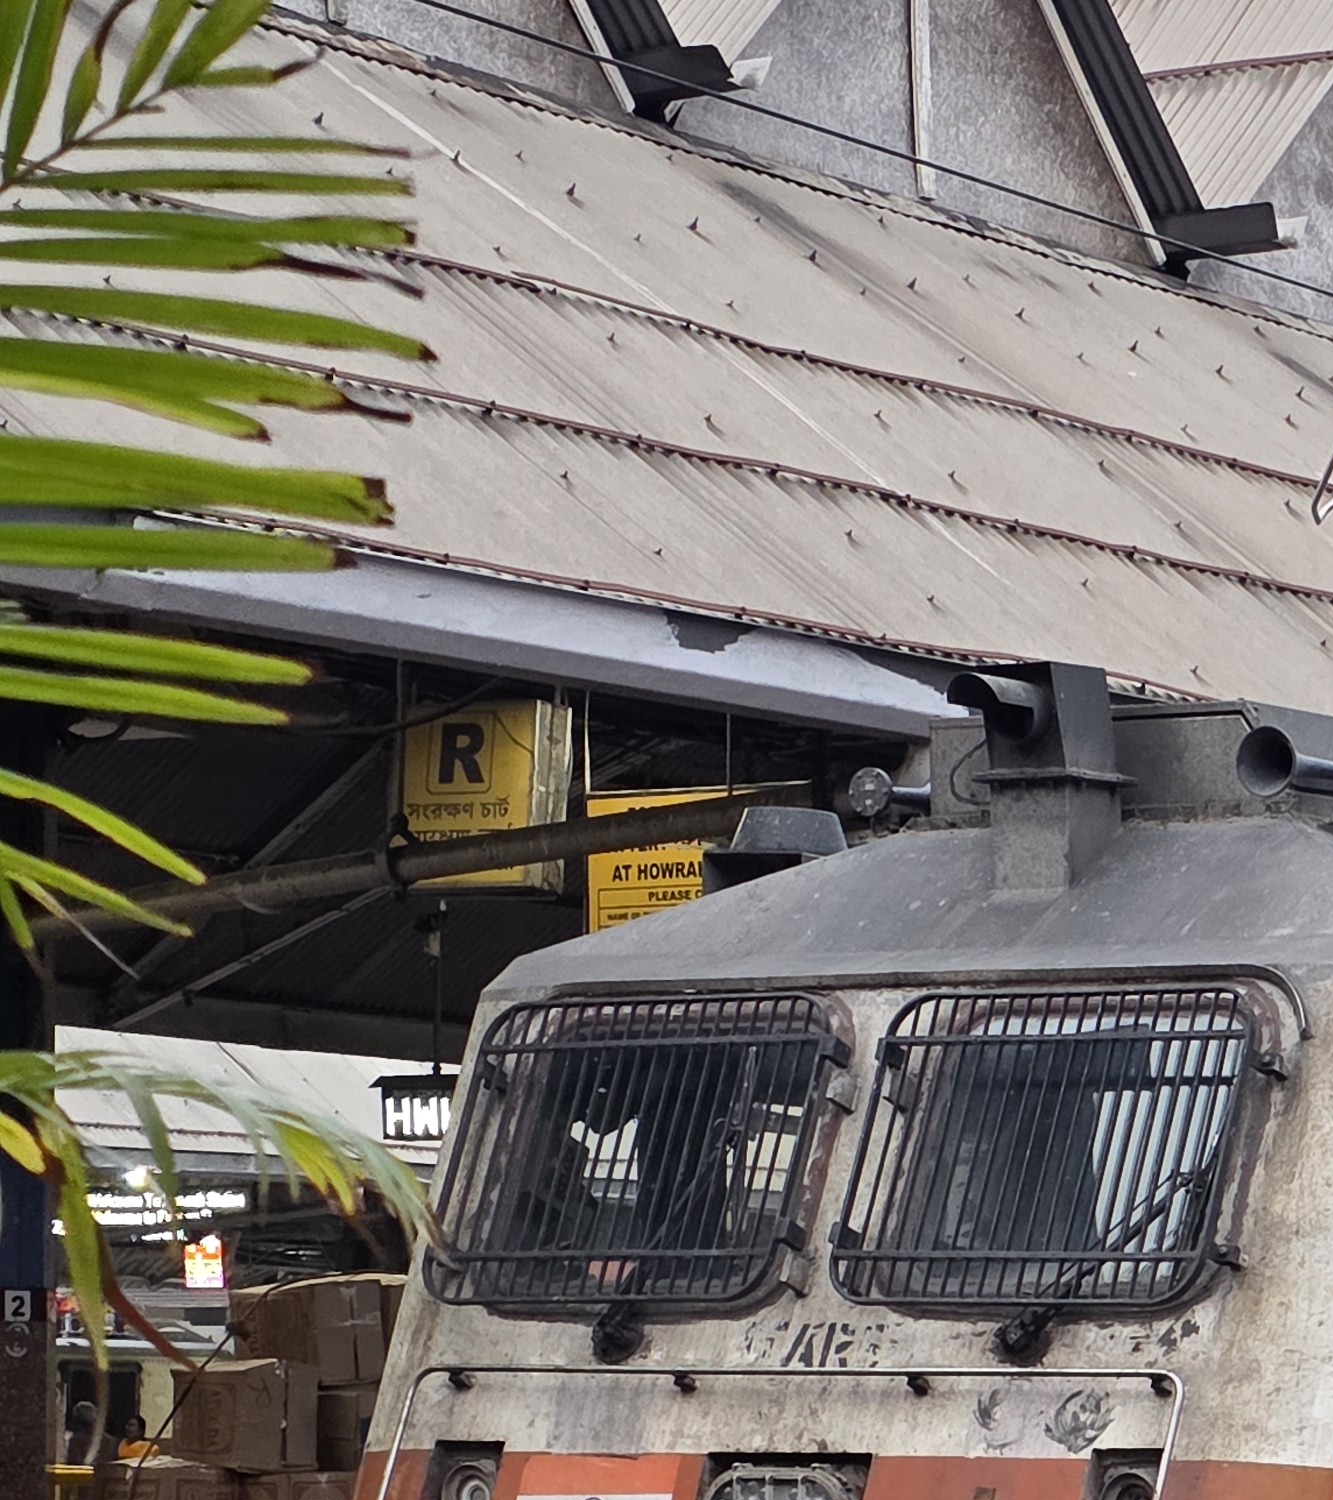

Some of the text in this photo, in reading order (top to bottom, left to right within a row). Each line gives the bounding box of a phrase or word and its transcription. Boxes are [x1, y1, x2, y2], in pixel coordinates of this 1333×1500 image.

[438, 723, 485, 784] R
[407, 802, 475, 820] সংরক্ষণ
[612, 861, 703, 882] AT HOWRA
[648, 889, 691, 902] PLEASE
[11, 1295, 26, 1317] 2
